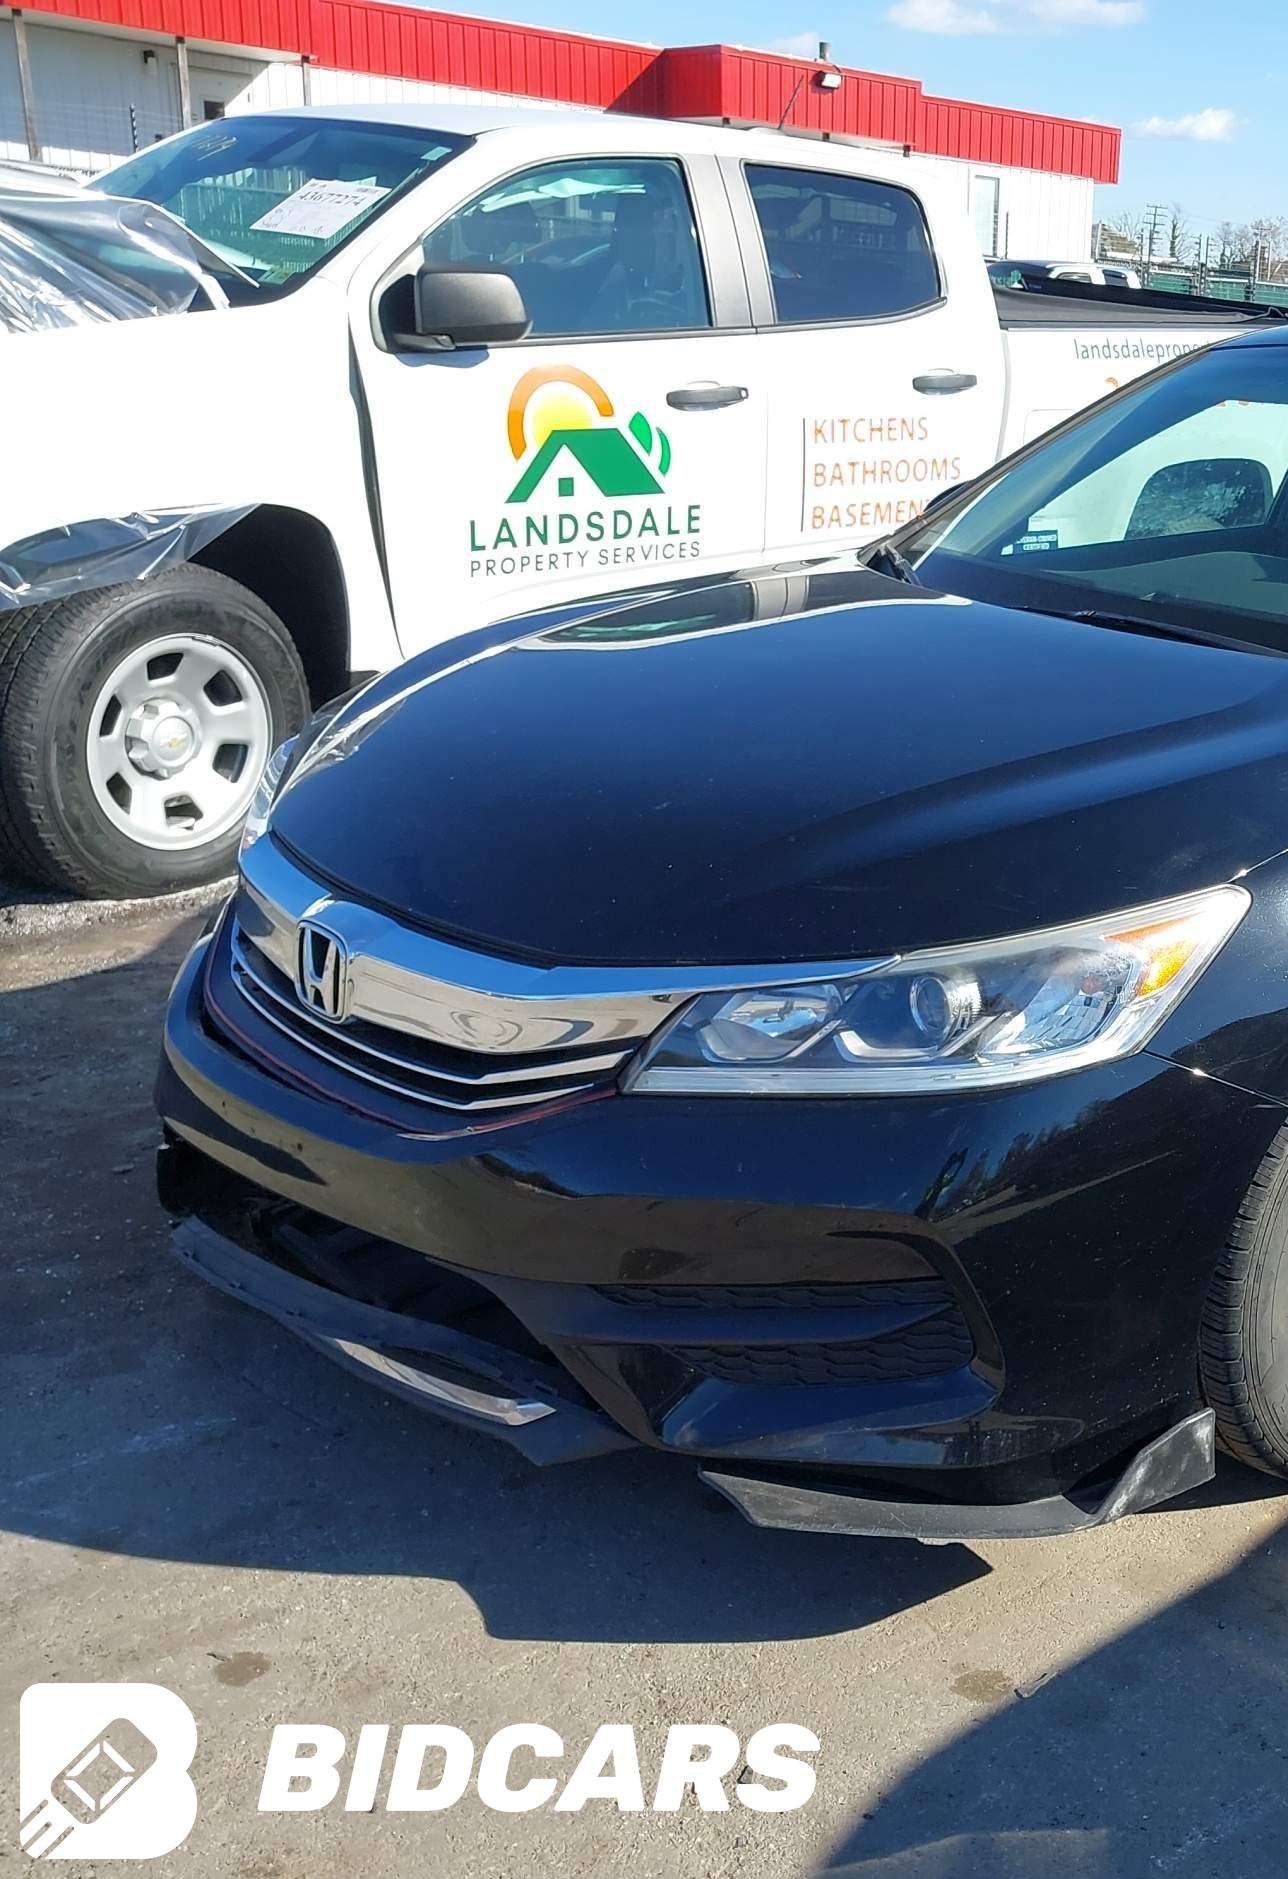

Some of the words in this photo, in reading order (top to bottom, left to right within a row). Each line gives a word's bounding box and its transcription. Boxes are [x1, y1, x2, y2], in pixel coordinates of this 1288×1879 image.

[813, 416, 929, 444] KITCHENS
[813, 456, 961, 488] BATHROOMS
[470, 504, 701, 552] LANDSDALE
[811, 498, 931, 530] BASEMEN
[470, 550, 589, 577] PROPERTY
[598, 541, 701, 566] SERVICES
